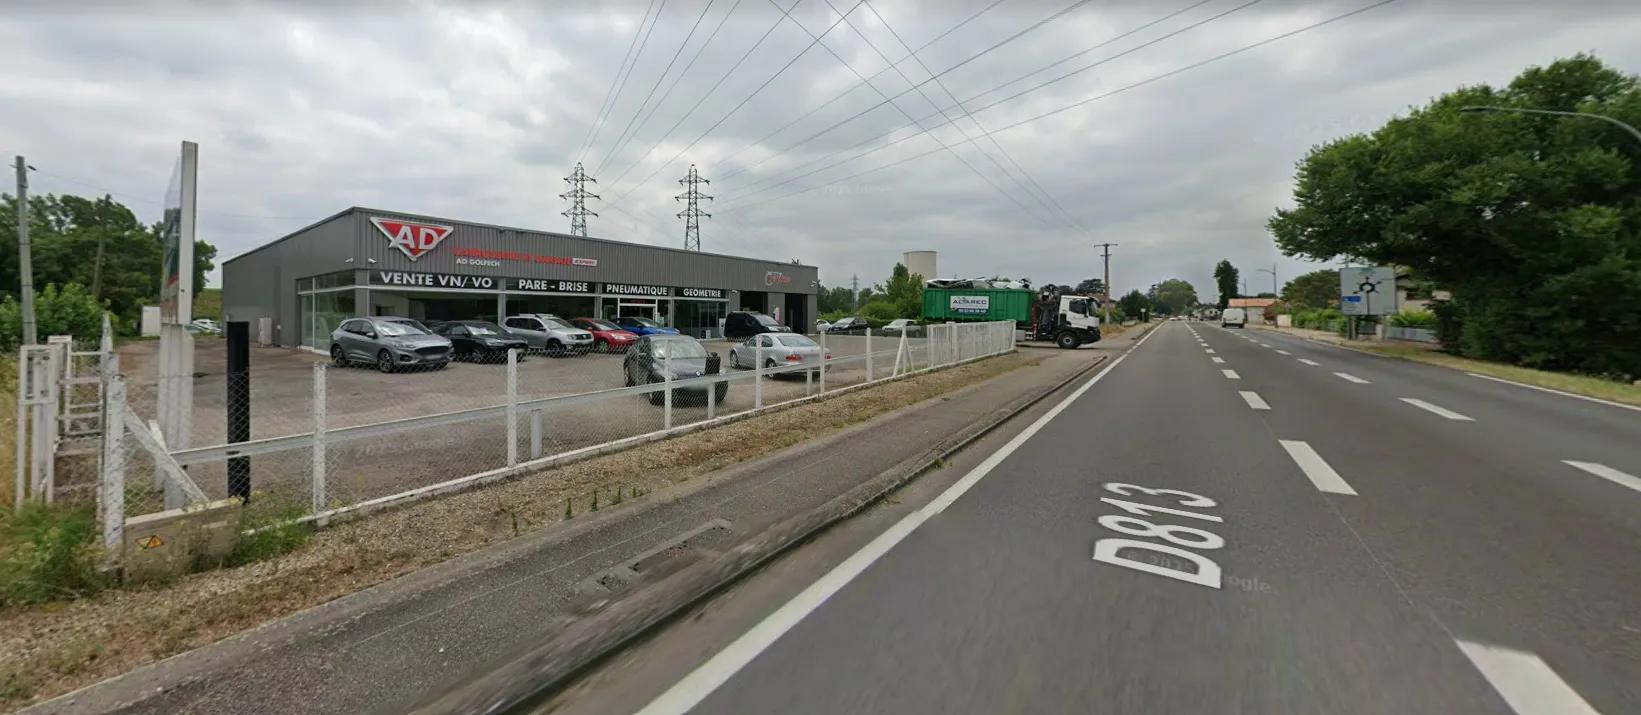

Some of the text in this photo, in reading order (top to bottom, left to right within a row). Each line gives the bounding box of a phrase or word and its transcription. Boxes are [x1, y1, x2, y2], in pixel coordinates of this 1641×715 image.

[388, 225, 440, 250] AD
[380, 271, 492, 288] VENTE VN/ VO
[519, 279, 547, 290] PARE
[559, 281, 588, 292] BRISE
[606, 284, 668, 296] PNEUMATIQUE
[683, 288, 721, 298] GEOMETRIE
[1092, 482, 1226, 589] D813
